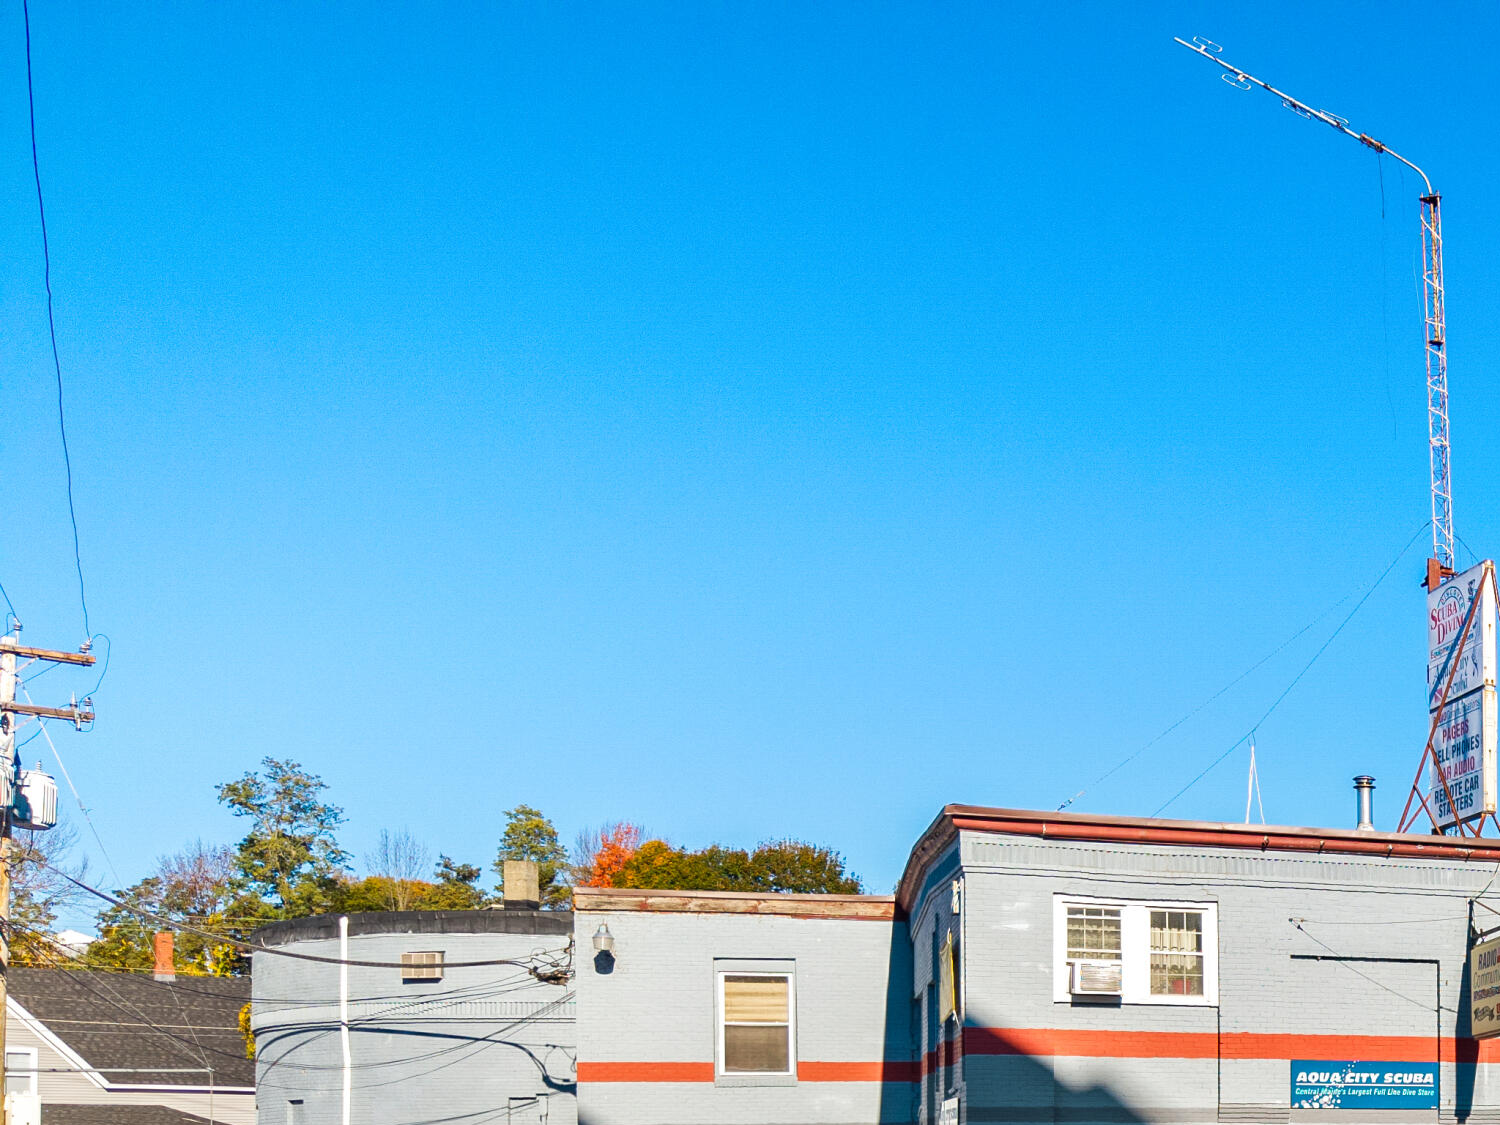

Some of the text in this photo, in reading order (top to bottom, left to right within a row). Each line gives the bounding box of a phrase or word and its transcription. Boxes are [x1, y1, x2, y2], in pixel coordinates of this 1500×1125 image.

[1431, 601, 1457, 630] SCUBA
[1442, 718, 1469, 743] PAGERS
[1451, 734, 1480, 758] PHONES
[1454, 756, 1475, 777] AUDIO
[1464, 774, 1480, 793] CAR
[1478, 948, 1497, 971] RADIO
[1296, 1072, 1434, 1084] AQUA CITY SCUBA
[1348, 1088, 1372, 1097] Largest
[1374, 1088, 1386, 1096] Full
[1387, 1088, 1401, 1096] Line
